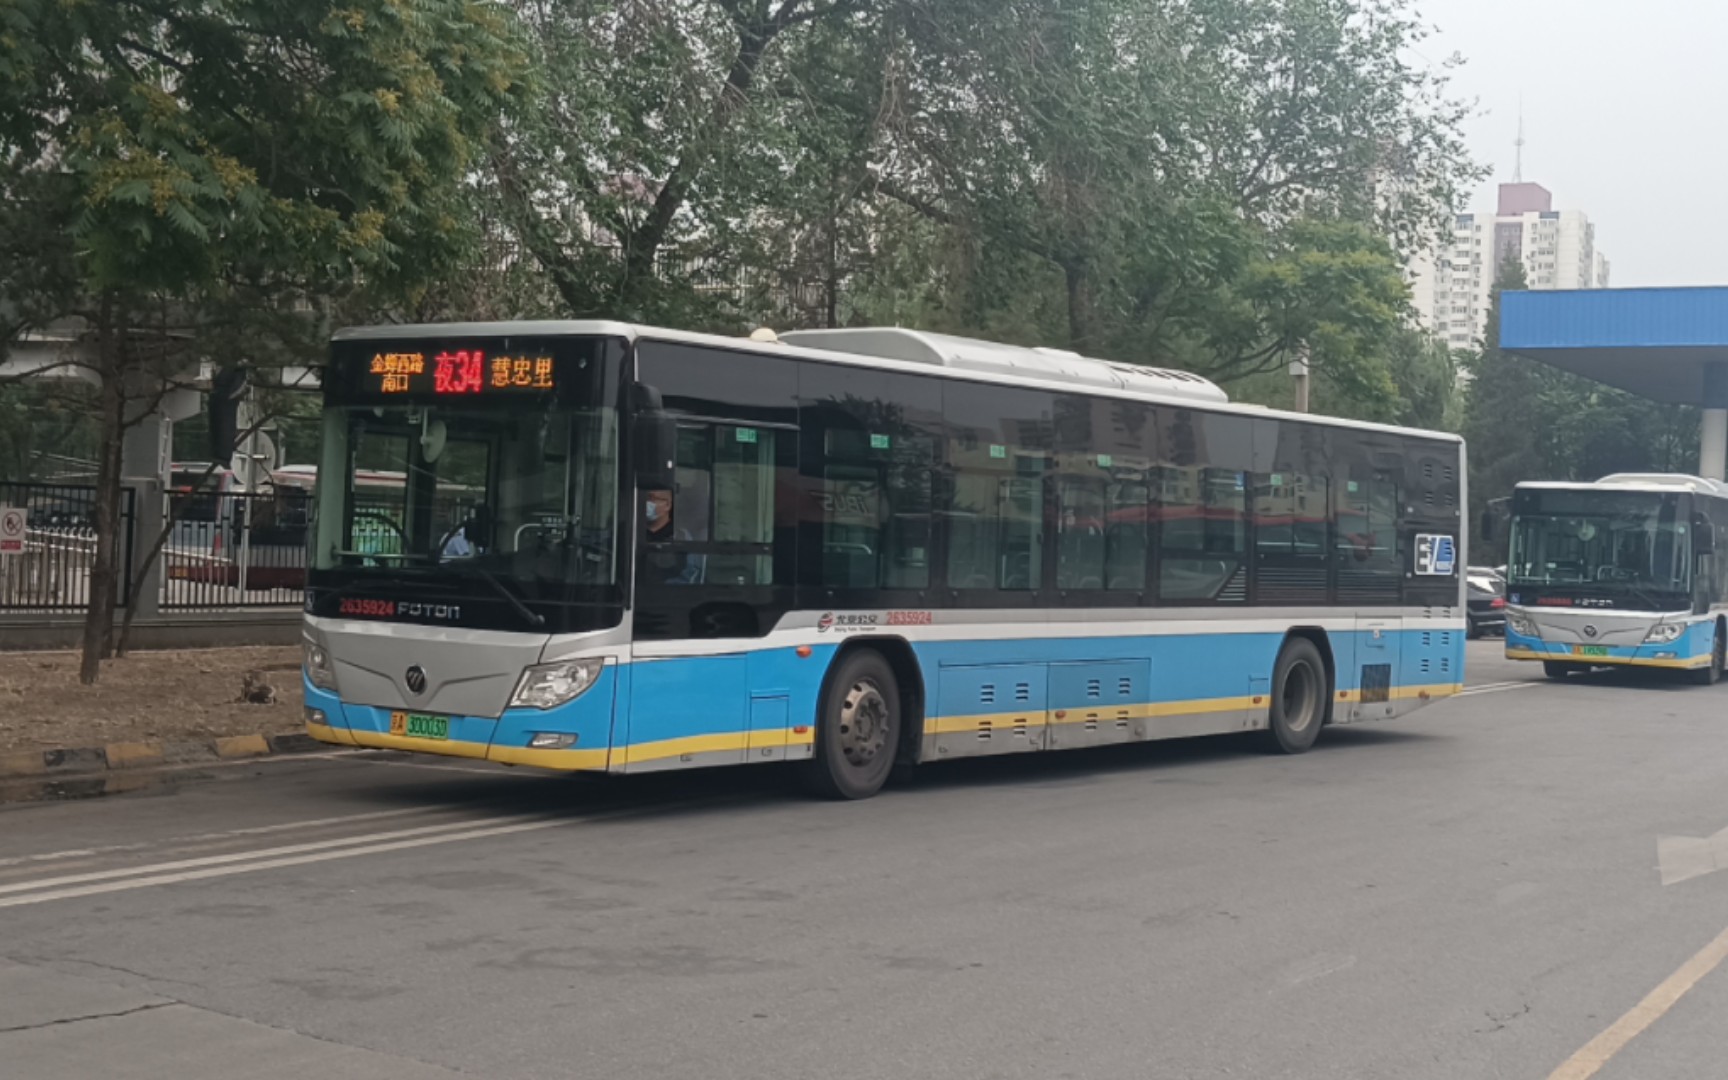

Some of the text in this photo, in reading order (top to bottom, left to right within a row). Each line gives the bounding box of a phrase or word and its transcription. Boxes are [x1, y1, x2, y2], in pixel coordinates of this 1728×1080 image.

[434, 352, 483, 392] 夜34
[491, 357, 554, 387] 慧忠里
[381, 373, 408, 392] 南口
[340, 599, 395, 615] 2635924
[886, 611, 932, 625] 2635924
